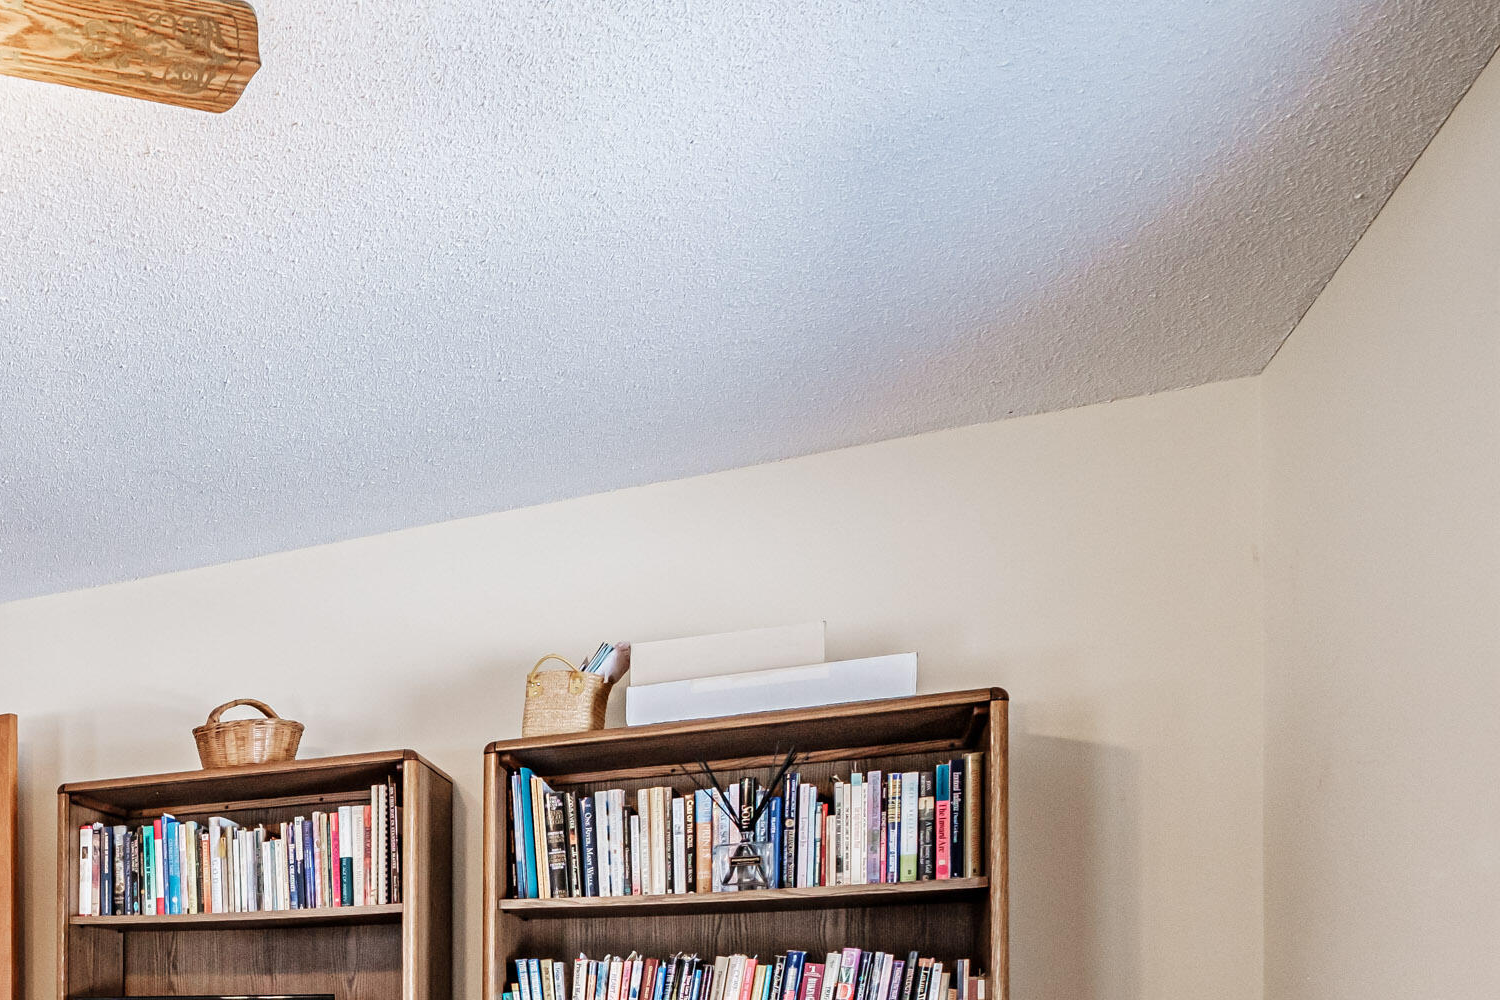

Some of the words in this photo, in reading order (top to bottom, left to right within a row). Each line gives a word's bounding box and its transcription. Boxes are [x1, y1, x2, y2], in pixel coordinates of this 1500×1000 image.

[939, 804, 948, 815] The
[686, 815, 693, 823] OF
[939, 817, 948, 839] Inward
[702, 824, 712, 858] PRINTS
[939, 841, 948, 854] Arc
[920, 970, 929, 993] Loving
